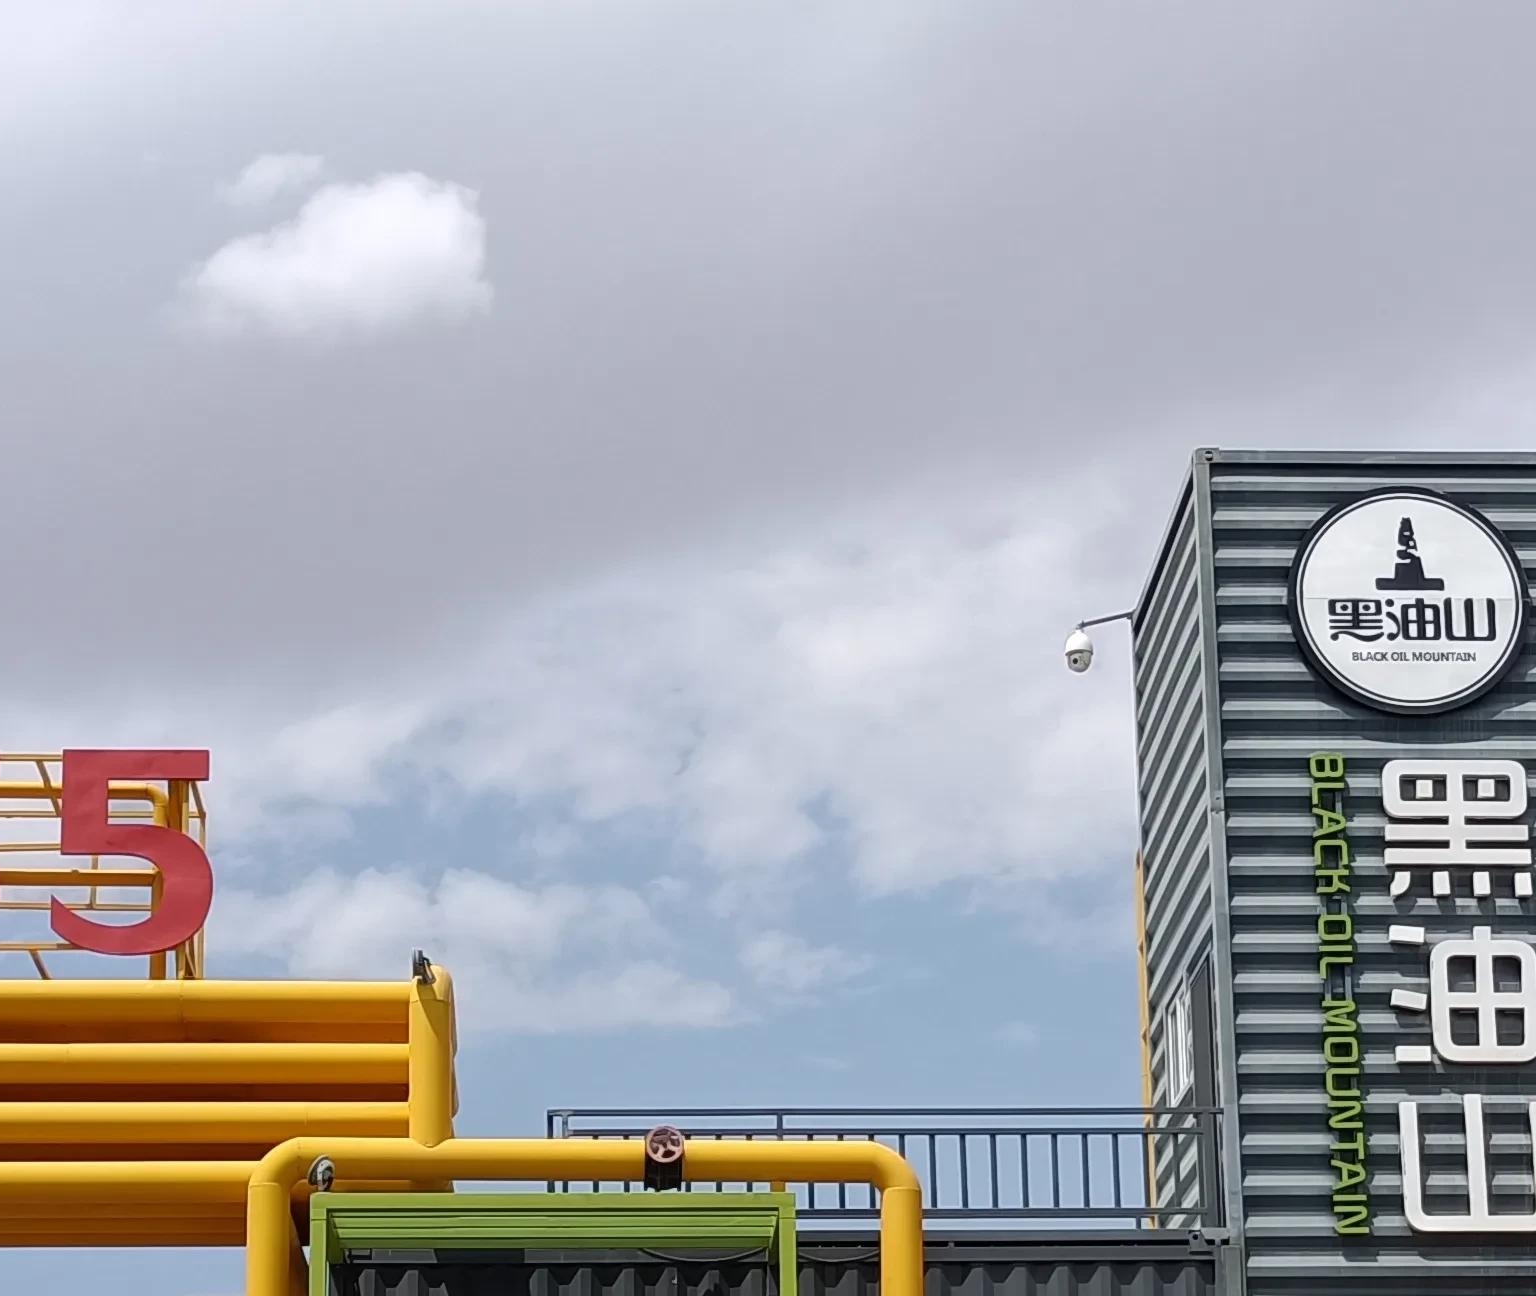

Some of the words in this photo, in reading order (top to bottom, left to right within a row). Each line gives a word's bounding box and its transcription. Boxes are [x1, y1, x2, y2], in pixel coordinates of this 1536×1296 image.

[1328, 598, 1496, 642] 黑油山
[1352, 651, 1388, 662] BLACK
[1390, 651, 1410, 662] OIL
[1412, 651, 1477, 662] MOUNTAIN
[1309, 752, 1352, 896] BLACK
[1317, 913, 1353, 980] OIL
[1321, 999, 1370, 1235] MOUNTAIN
